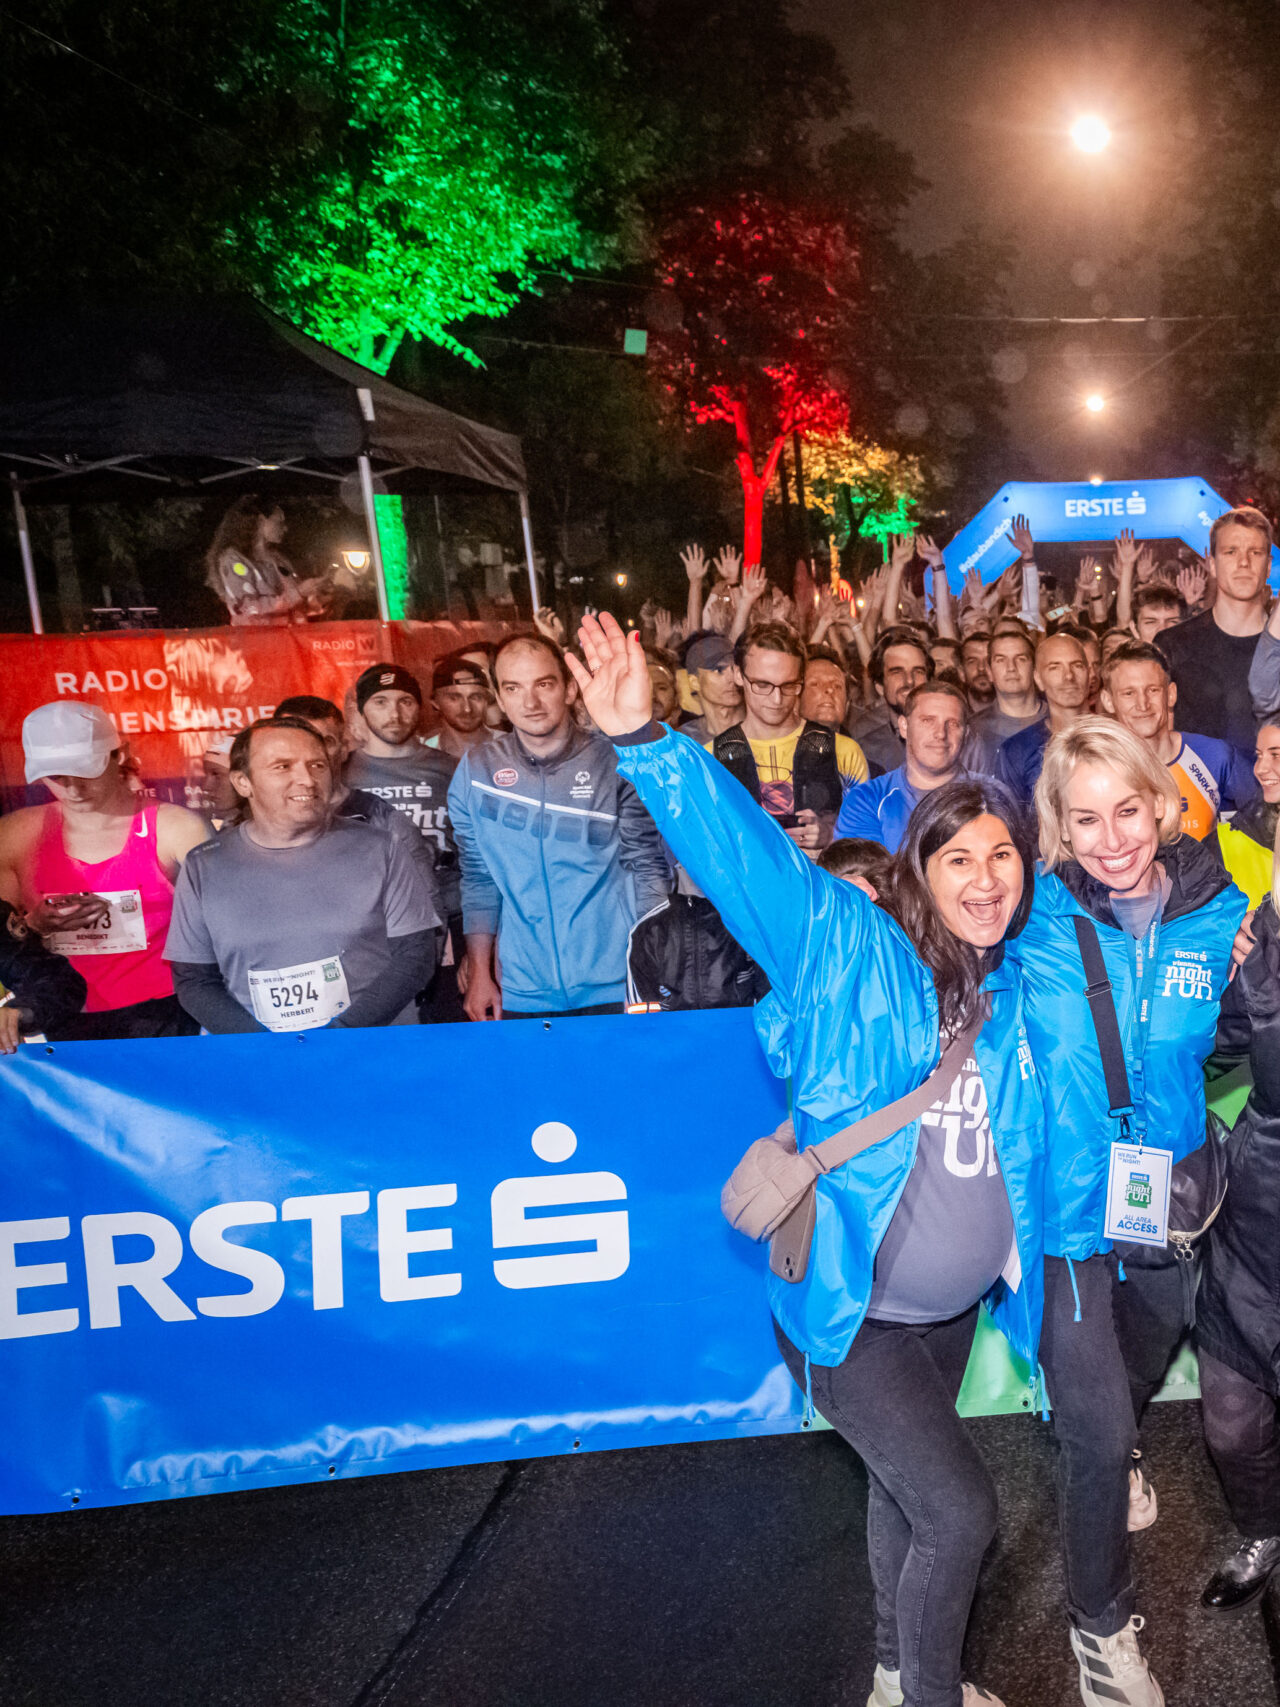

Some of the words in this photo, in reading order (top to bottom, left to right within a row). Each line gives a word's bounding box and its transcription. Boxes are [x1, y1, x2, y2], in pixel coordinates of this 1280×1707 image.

[1065, 498, 1124, 518] ERSTE
[312, 640, 355, 651] RADIO
[54, 668, 168, 694] RADIO
[109, 705, 275, 734] IENSPIRIE
[1174, 950, 1200, 961] ERSTE
[1165, 963, 1213, 985] night
[270, 981, 319, 1008] 5294
[1162, 978, 1213, 1000] run
[281, 1007, 315, 1019] HERBERT
[1125, 1190, 1150, 1204] run
[1117, 1219, 1158, 1235] ACCESS
[0, 1183, 463, 1341] ERSTE
